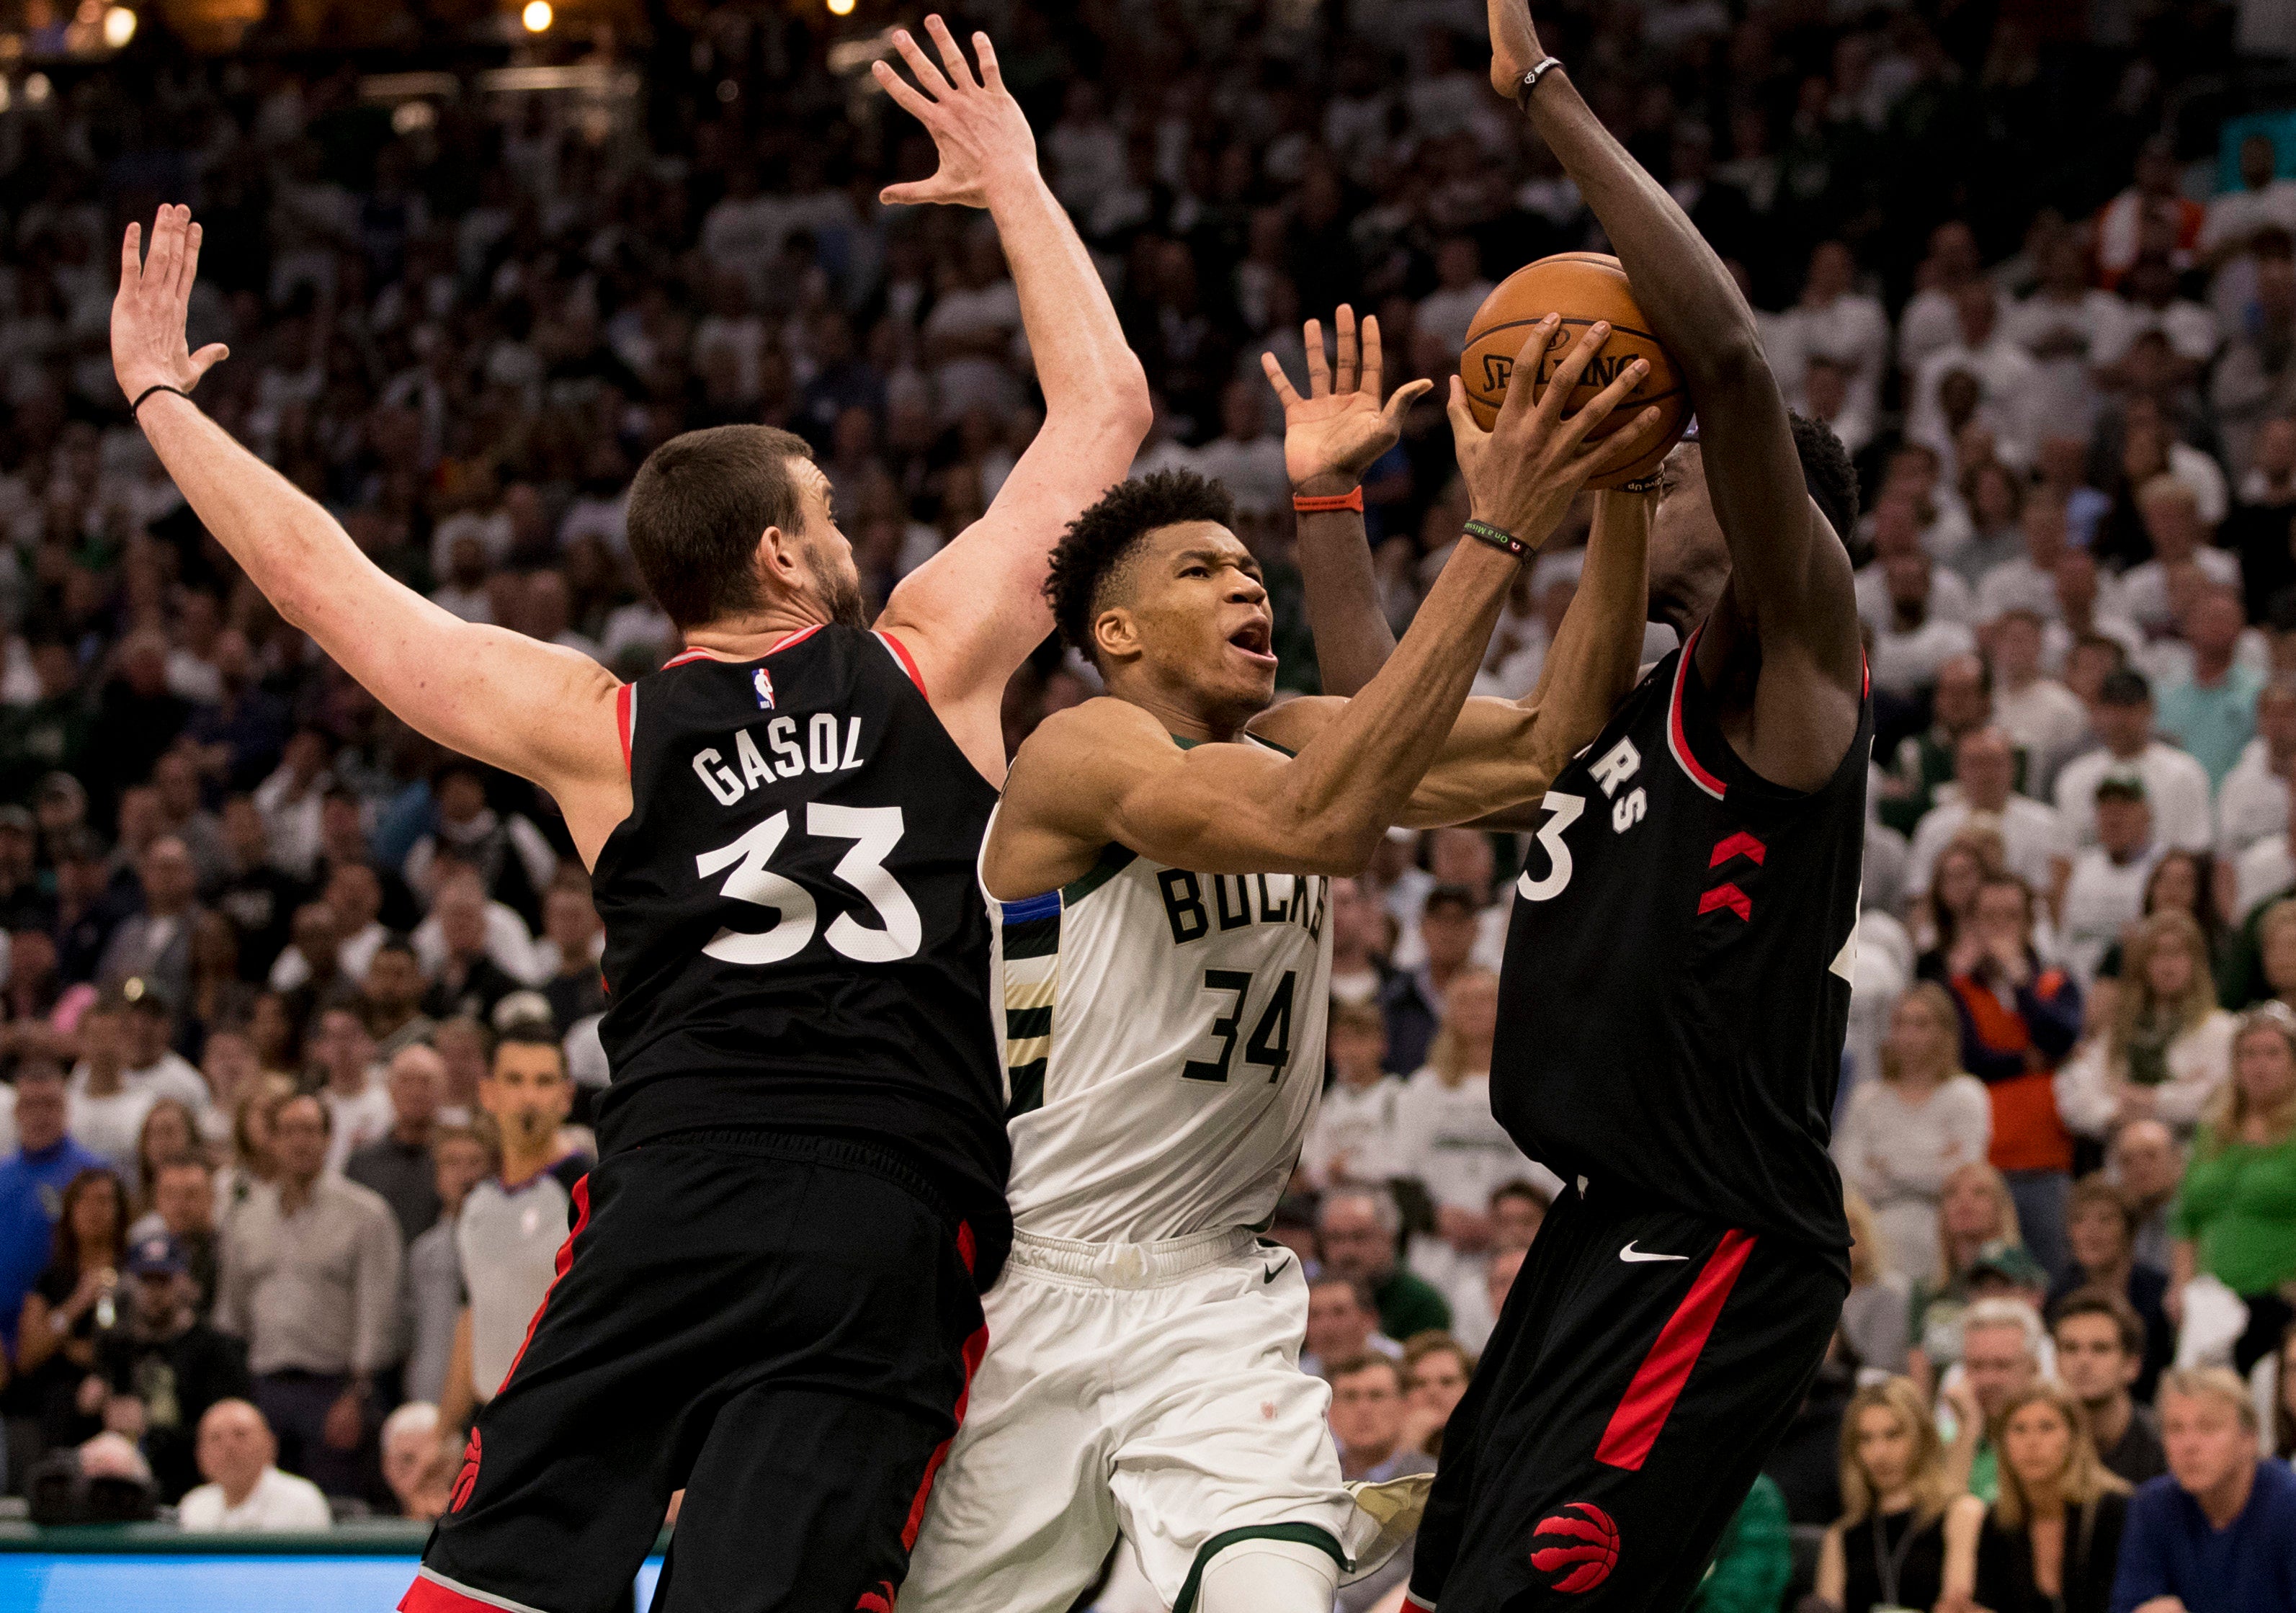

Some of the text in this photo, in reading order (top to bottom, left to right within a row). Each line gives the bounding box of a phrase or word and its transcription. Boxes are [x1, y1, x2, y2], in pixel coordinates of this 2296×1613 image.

[1495, 532, 1509, 543] On
[692, 713, 864, 805] GASOL
[1588, 736, 1647, 834] RS
[696, 802, 921, 964] 33
[1156, 867, 1328, 945] BUCKS
[1181, 970, 1296, 1083] 34
